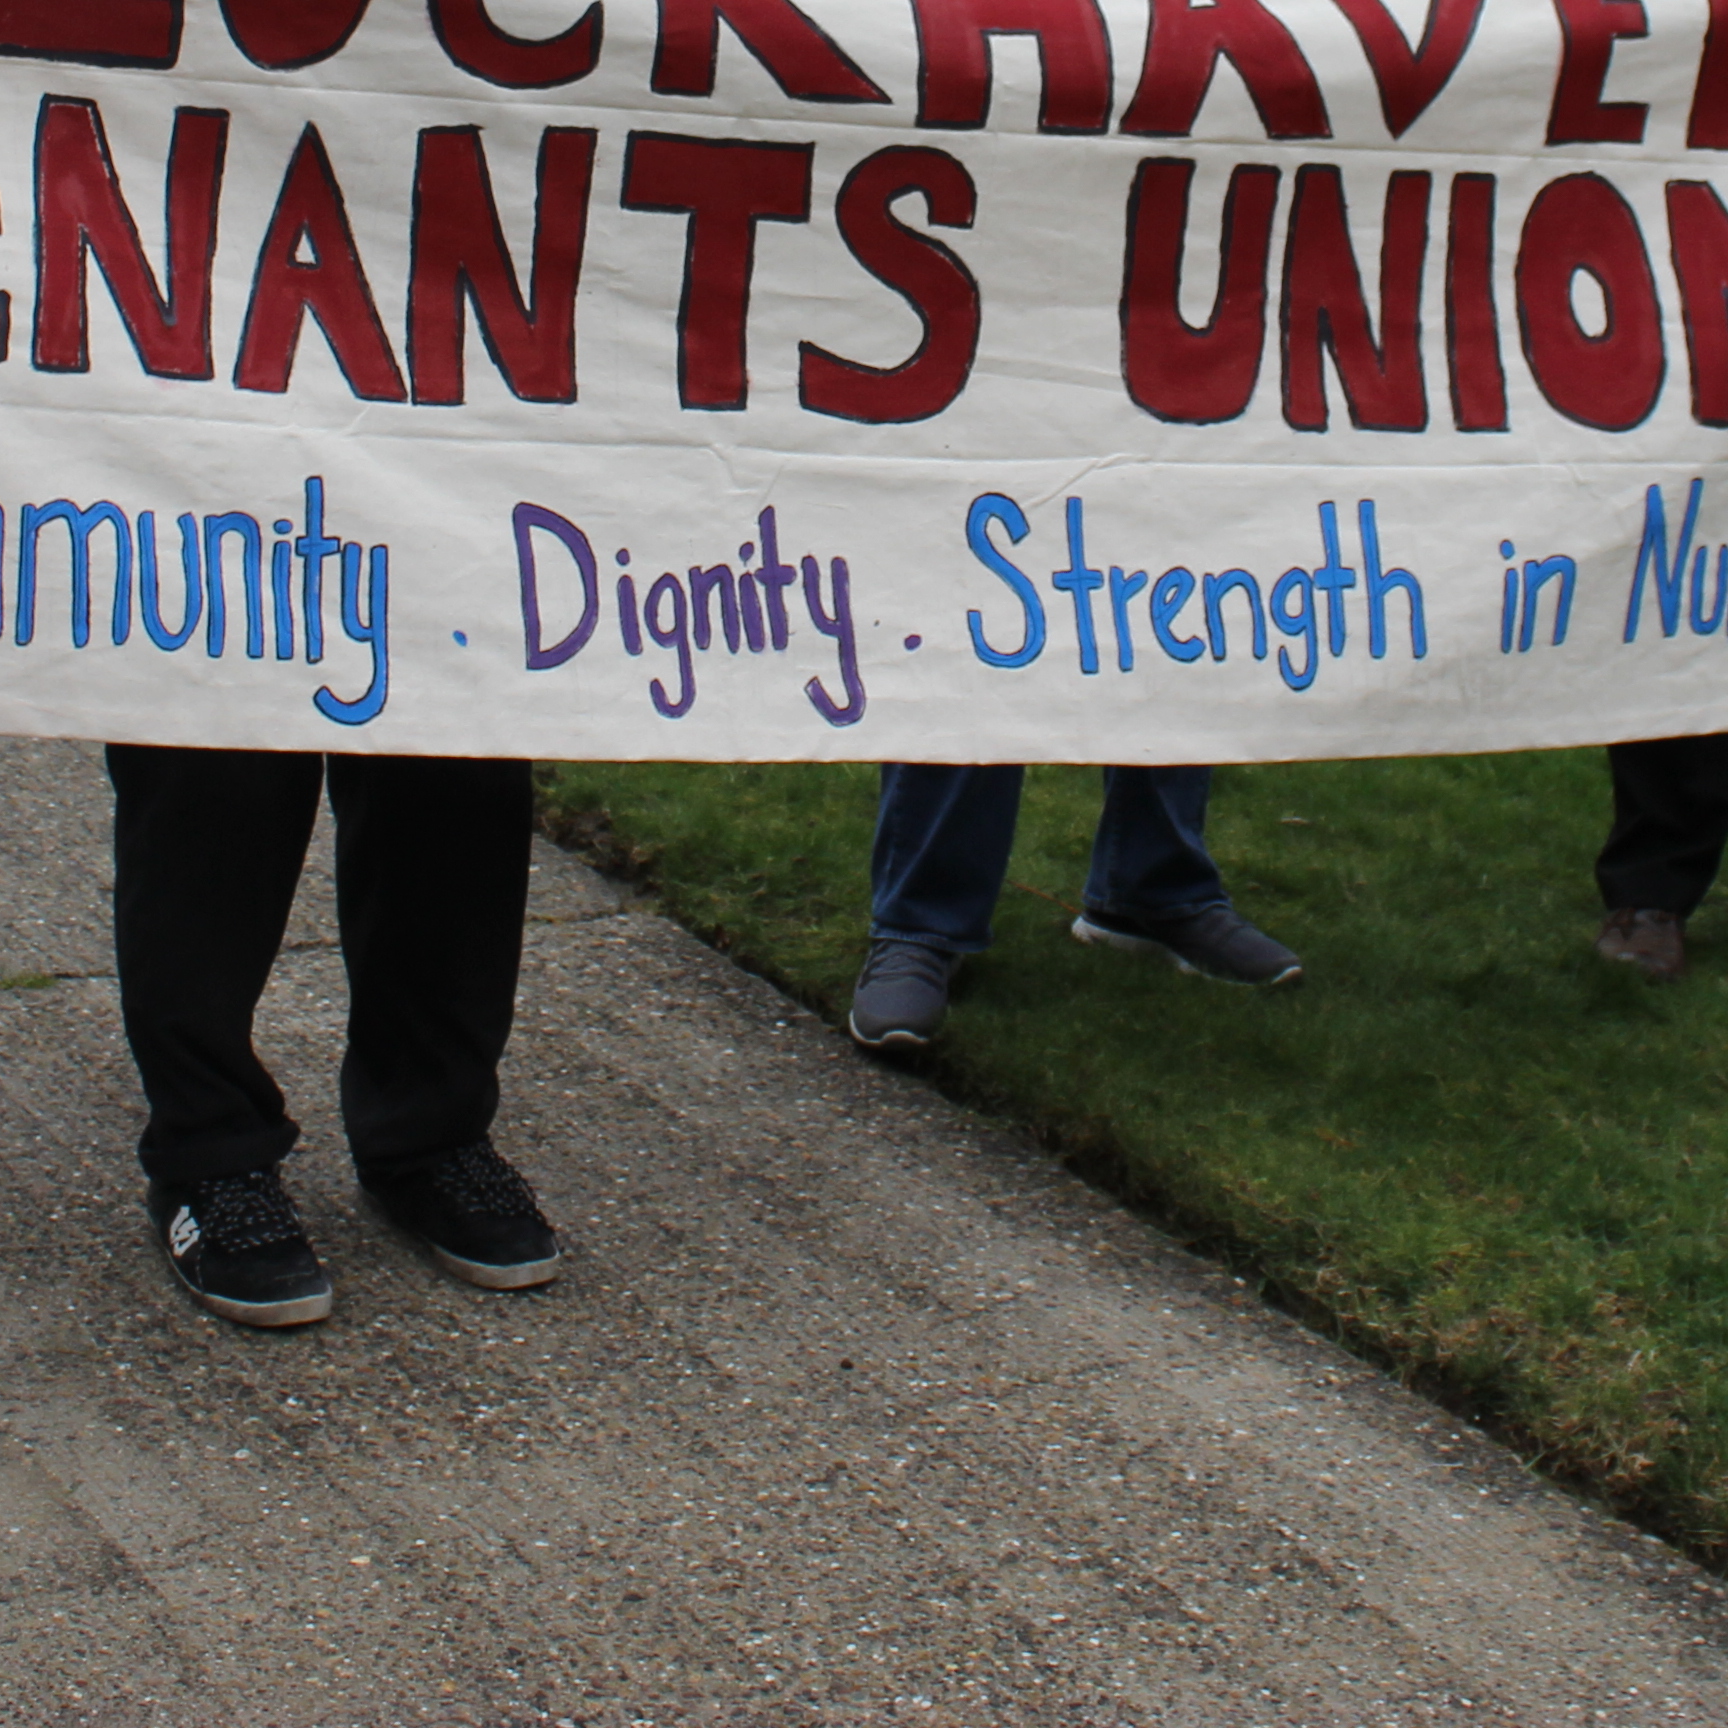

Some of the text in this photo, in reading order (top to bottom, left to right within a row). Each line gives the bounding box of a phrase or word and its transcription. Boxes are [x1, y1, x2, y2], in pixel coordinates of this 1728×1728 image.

[512, 502, 864, 727] Dignity
[965, 492, 1426, 692] Strength
[1499, 539, 1577, 654] in
